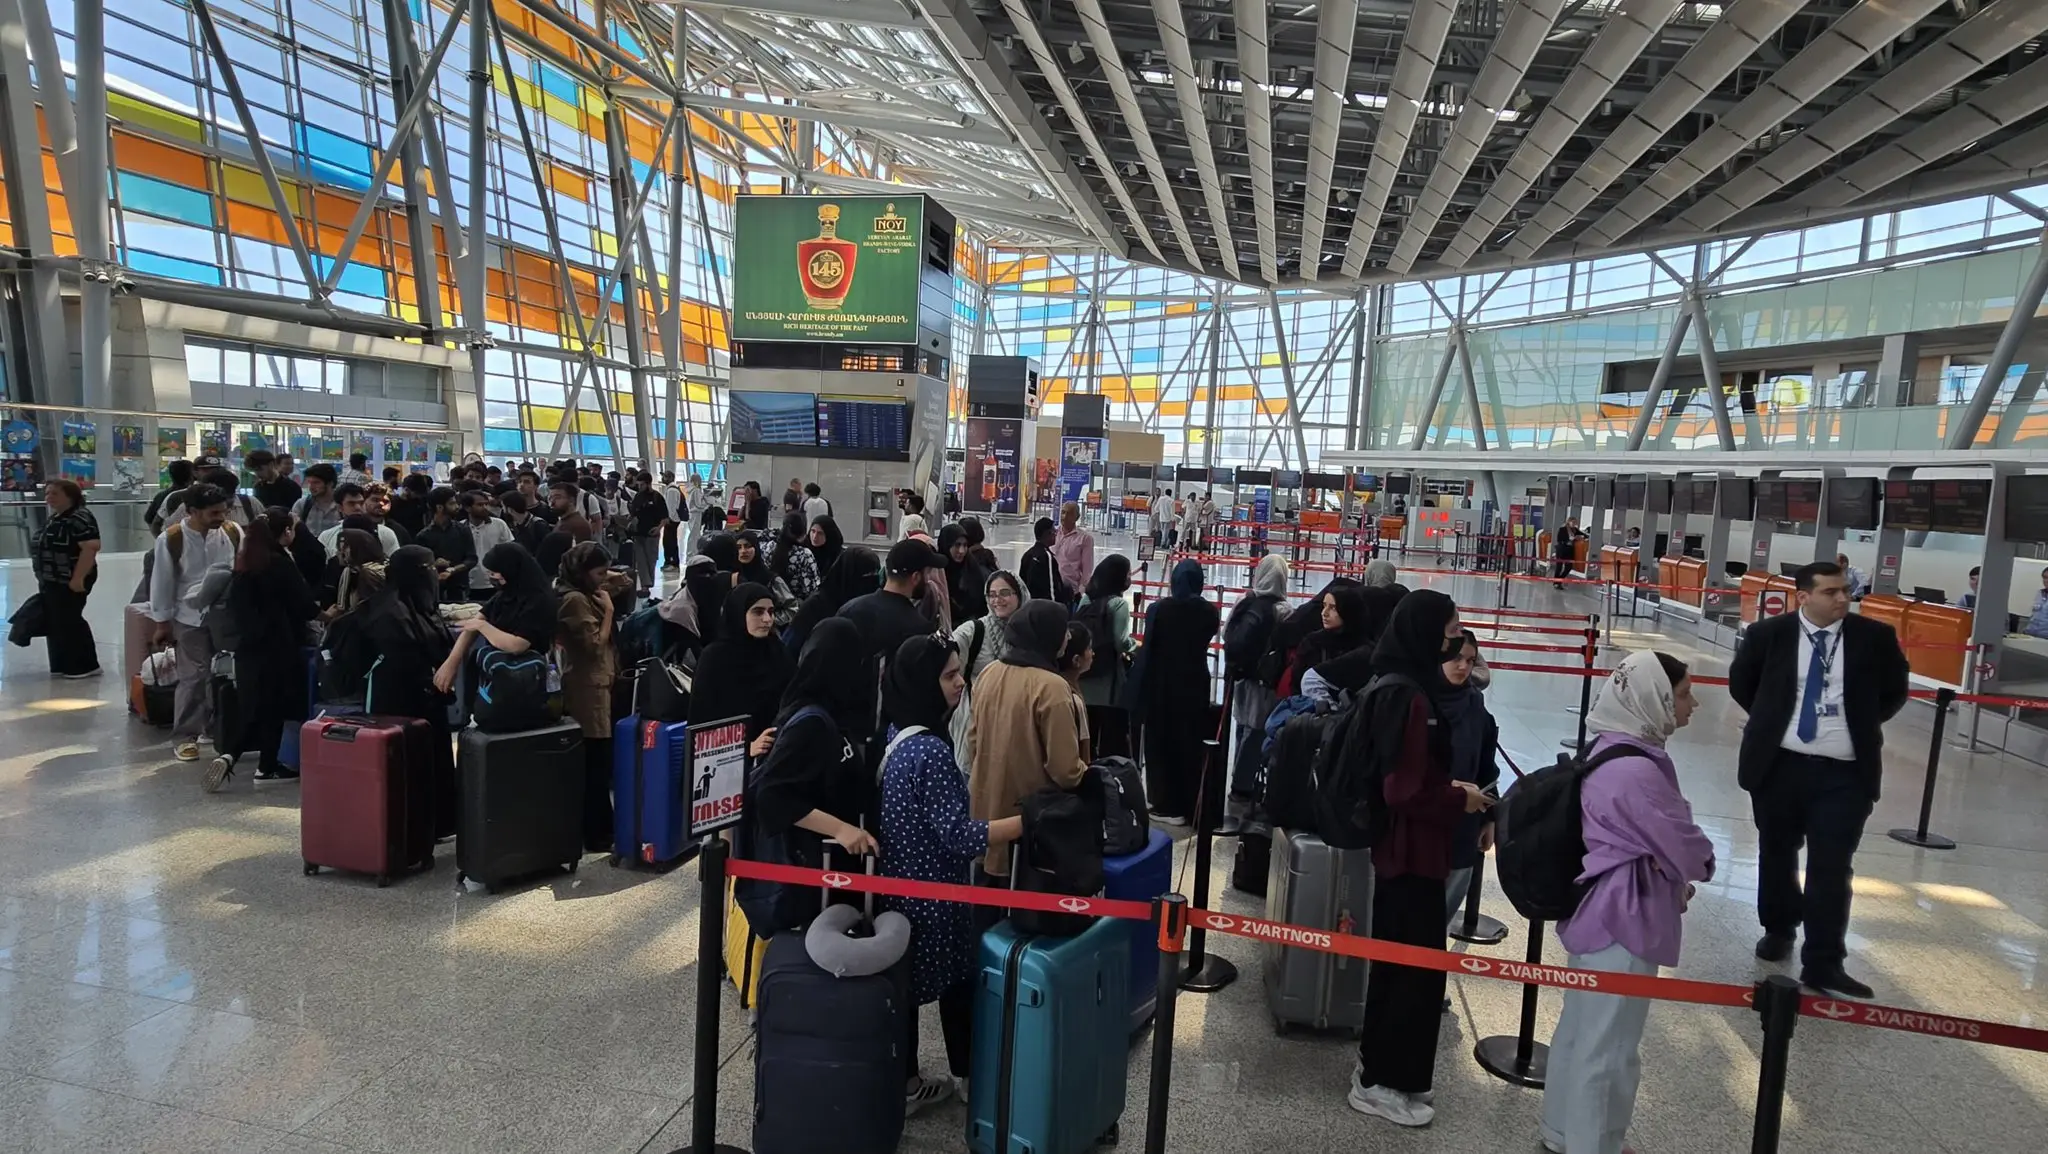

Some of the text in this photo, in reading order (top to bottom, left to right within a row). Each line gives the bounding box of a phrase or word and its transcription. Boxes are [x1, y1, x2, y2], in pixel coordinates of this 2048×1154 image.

[878, 220, 902, 230] NOY
[812, 262, 841, 277] 145
[745, 312, 785, 321] ԱՆՑՅԱԼԻ
[786, 313, 826, 322] ՀԱՐՈՒՍՏ
[701, 745, 734, 759] PASSENGERS
[1241, 920, 1331, 948] ZVARTNOTS
[1499, 963, 1598, 988] ZVARTNOTS
[1864, 1008, 1981, 1038] ZVARTNOTS
